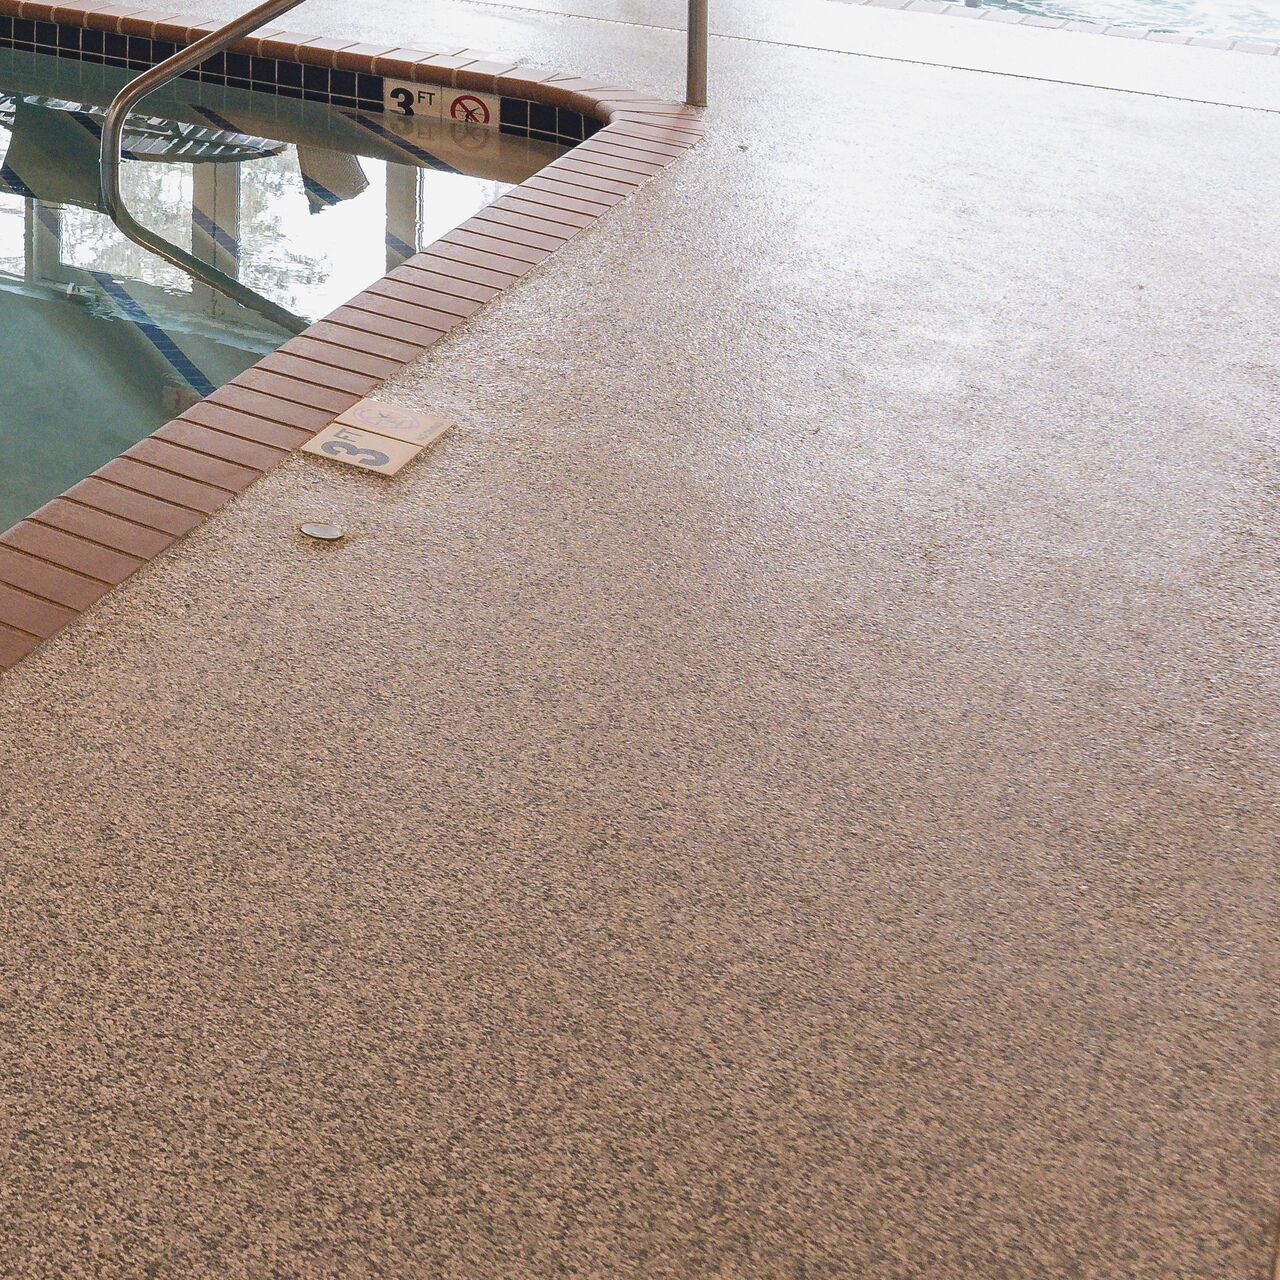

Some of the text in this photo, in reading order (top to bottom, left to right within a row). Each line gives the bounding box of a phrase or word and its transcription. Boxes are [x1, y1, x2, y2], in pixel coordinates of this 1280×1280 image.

[390, 87, 436, 116] 3 FT
[321, 428, 390, 467] 3 FT
